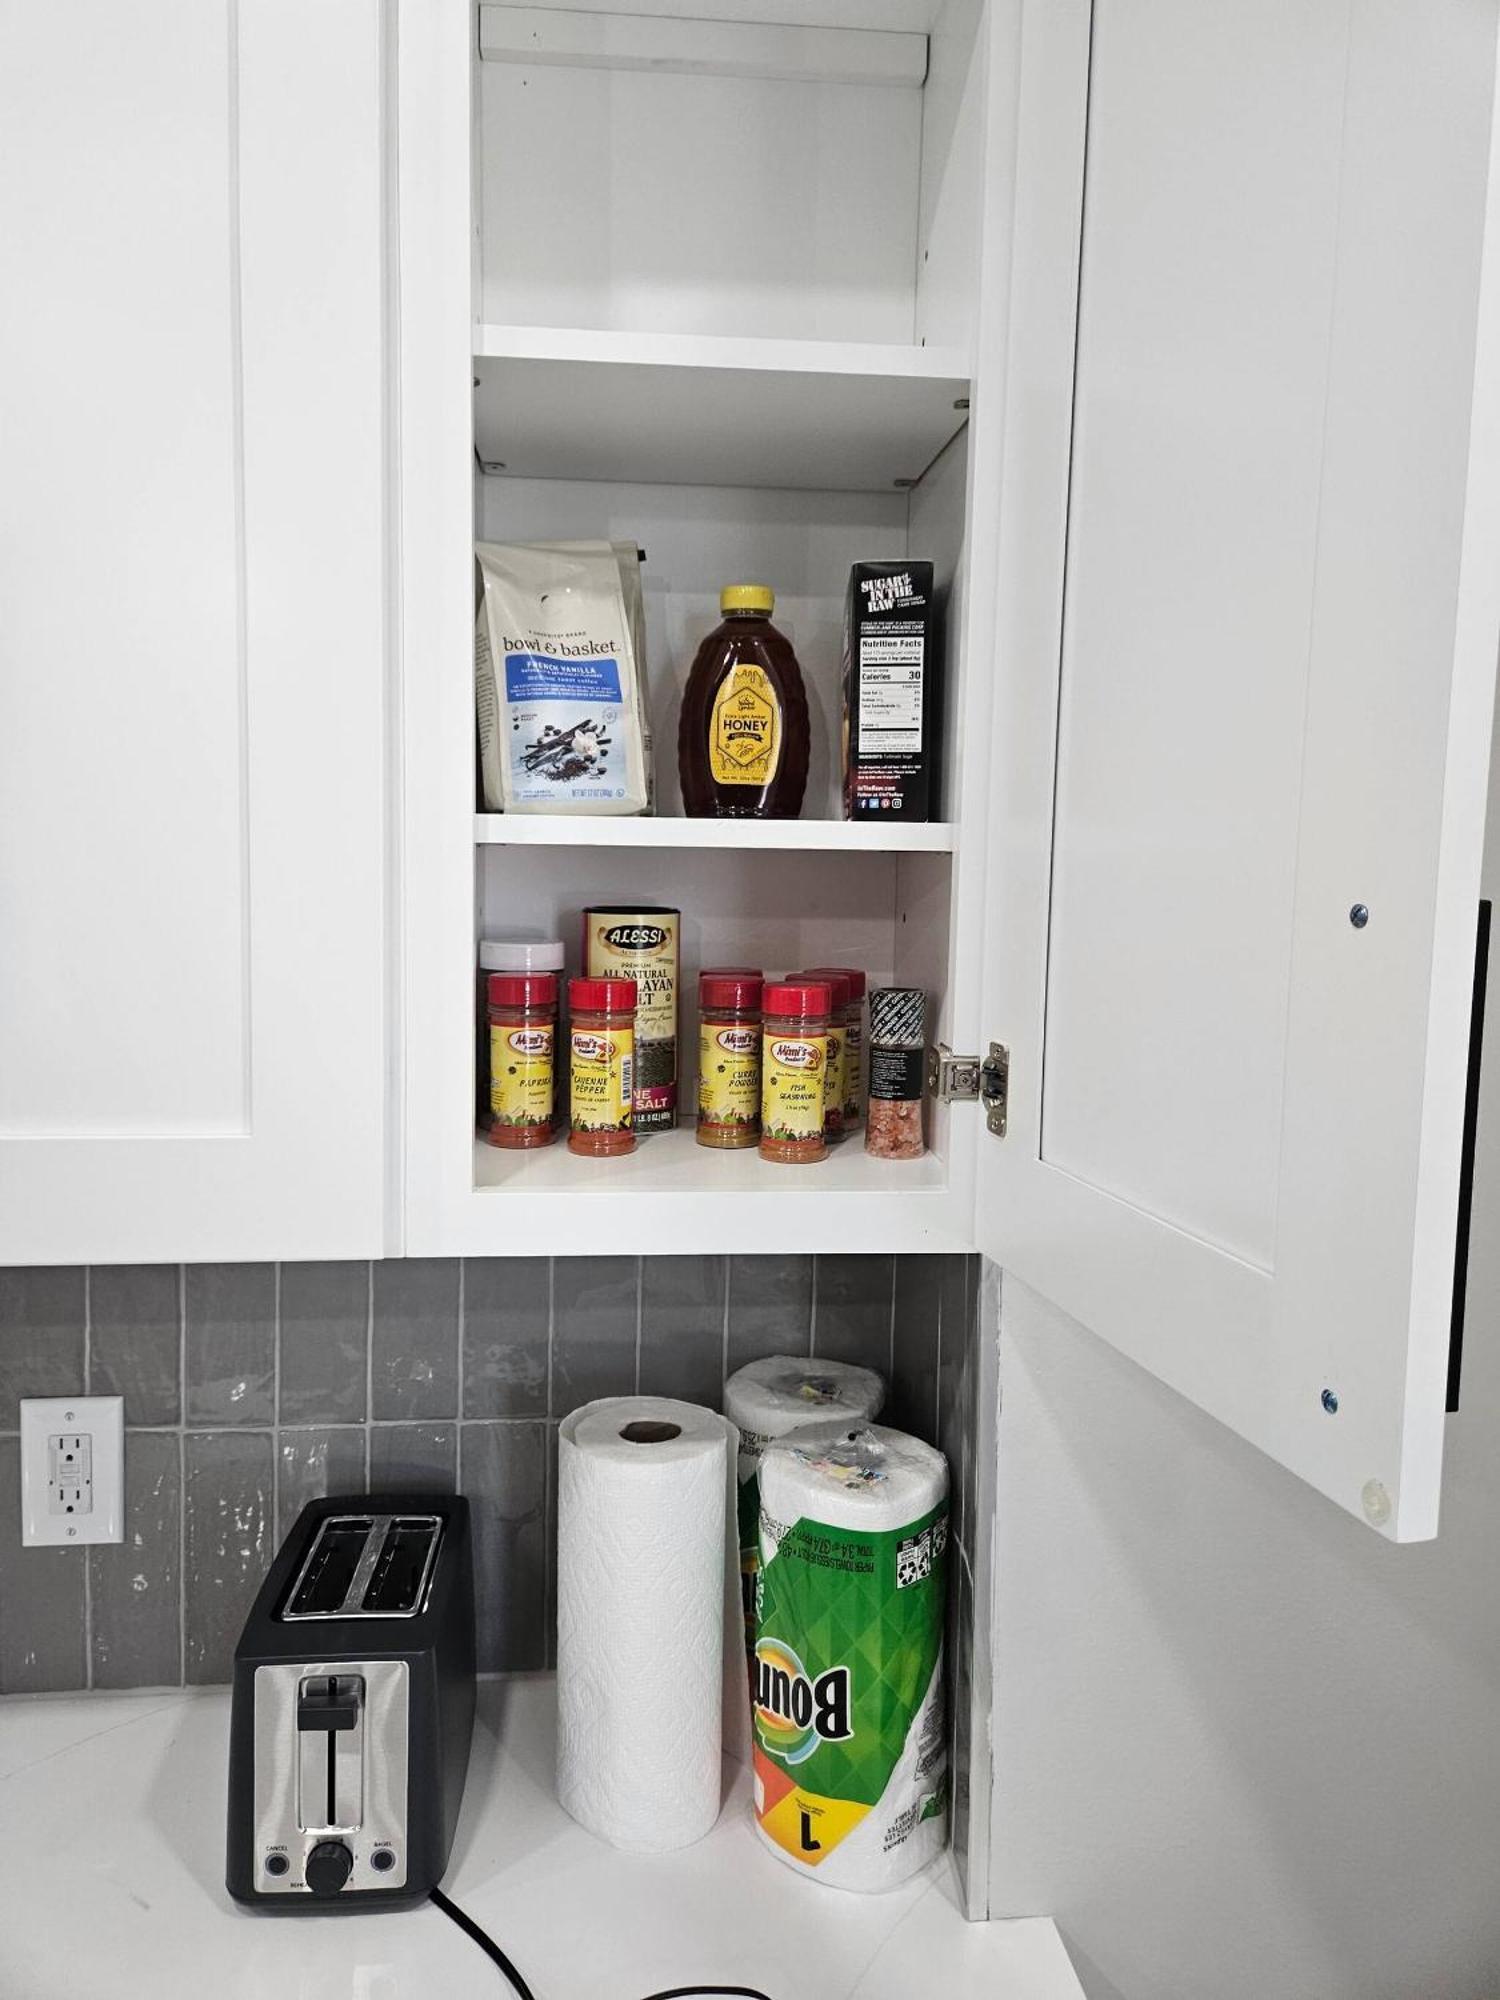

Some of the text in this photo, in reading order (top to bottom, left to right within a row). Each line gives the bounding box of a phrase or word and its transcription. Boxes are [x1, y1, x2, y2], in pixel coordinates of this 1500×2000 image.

[861, 575, 903, 593] SUGAR
[870, 585, 913, 601] IN THE
[868, 599, 895, 612] RAW
[503, 636, 616, 656] bowl & basket
[862, 640, 922, 648] Nutrition Facts
[561, 666, 597, 674] VANILLA
[909, 670, 921, 680] 30
[723, 720, 768, 731] HONEY
[610, 929, 662, 943] ALESSI
[603, 969, 667, 979] ALL NATURAL
[640, 978, 672, 992] AYAN
[777, 1045, 807, 1057] Mimi's
[575, 1084, 606, 1094] PEPPER
[634, 1090, 652, 1100] NE
[636, 1097, 668, 1111] SALT
[801, 1809, 821, 1851] 1
